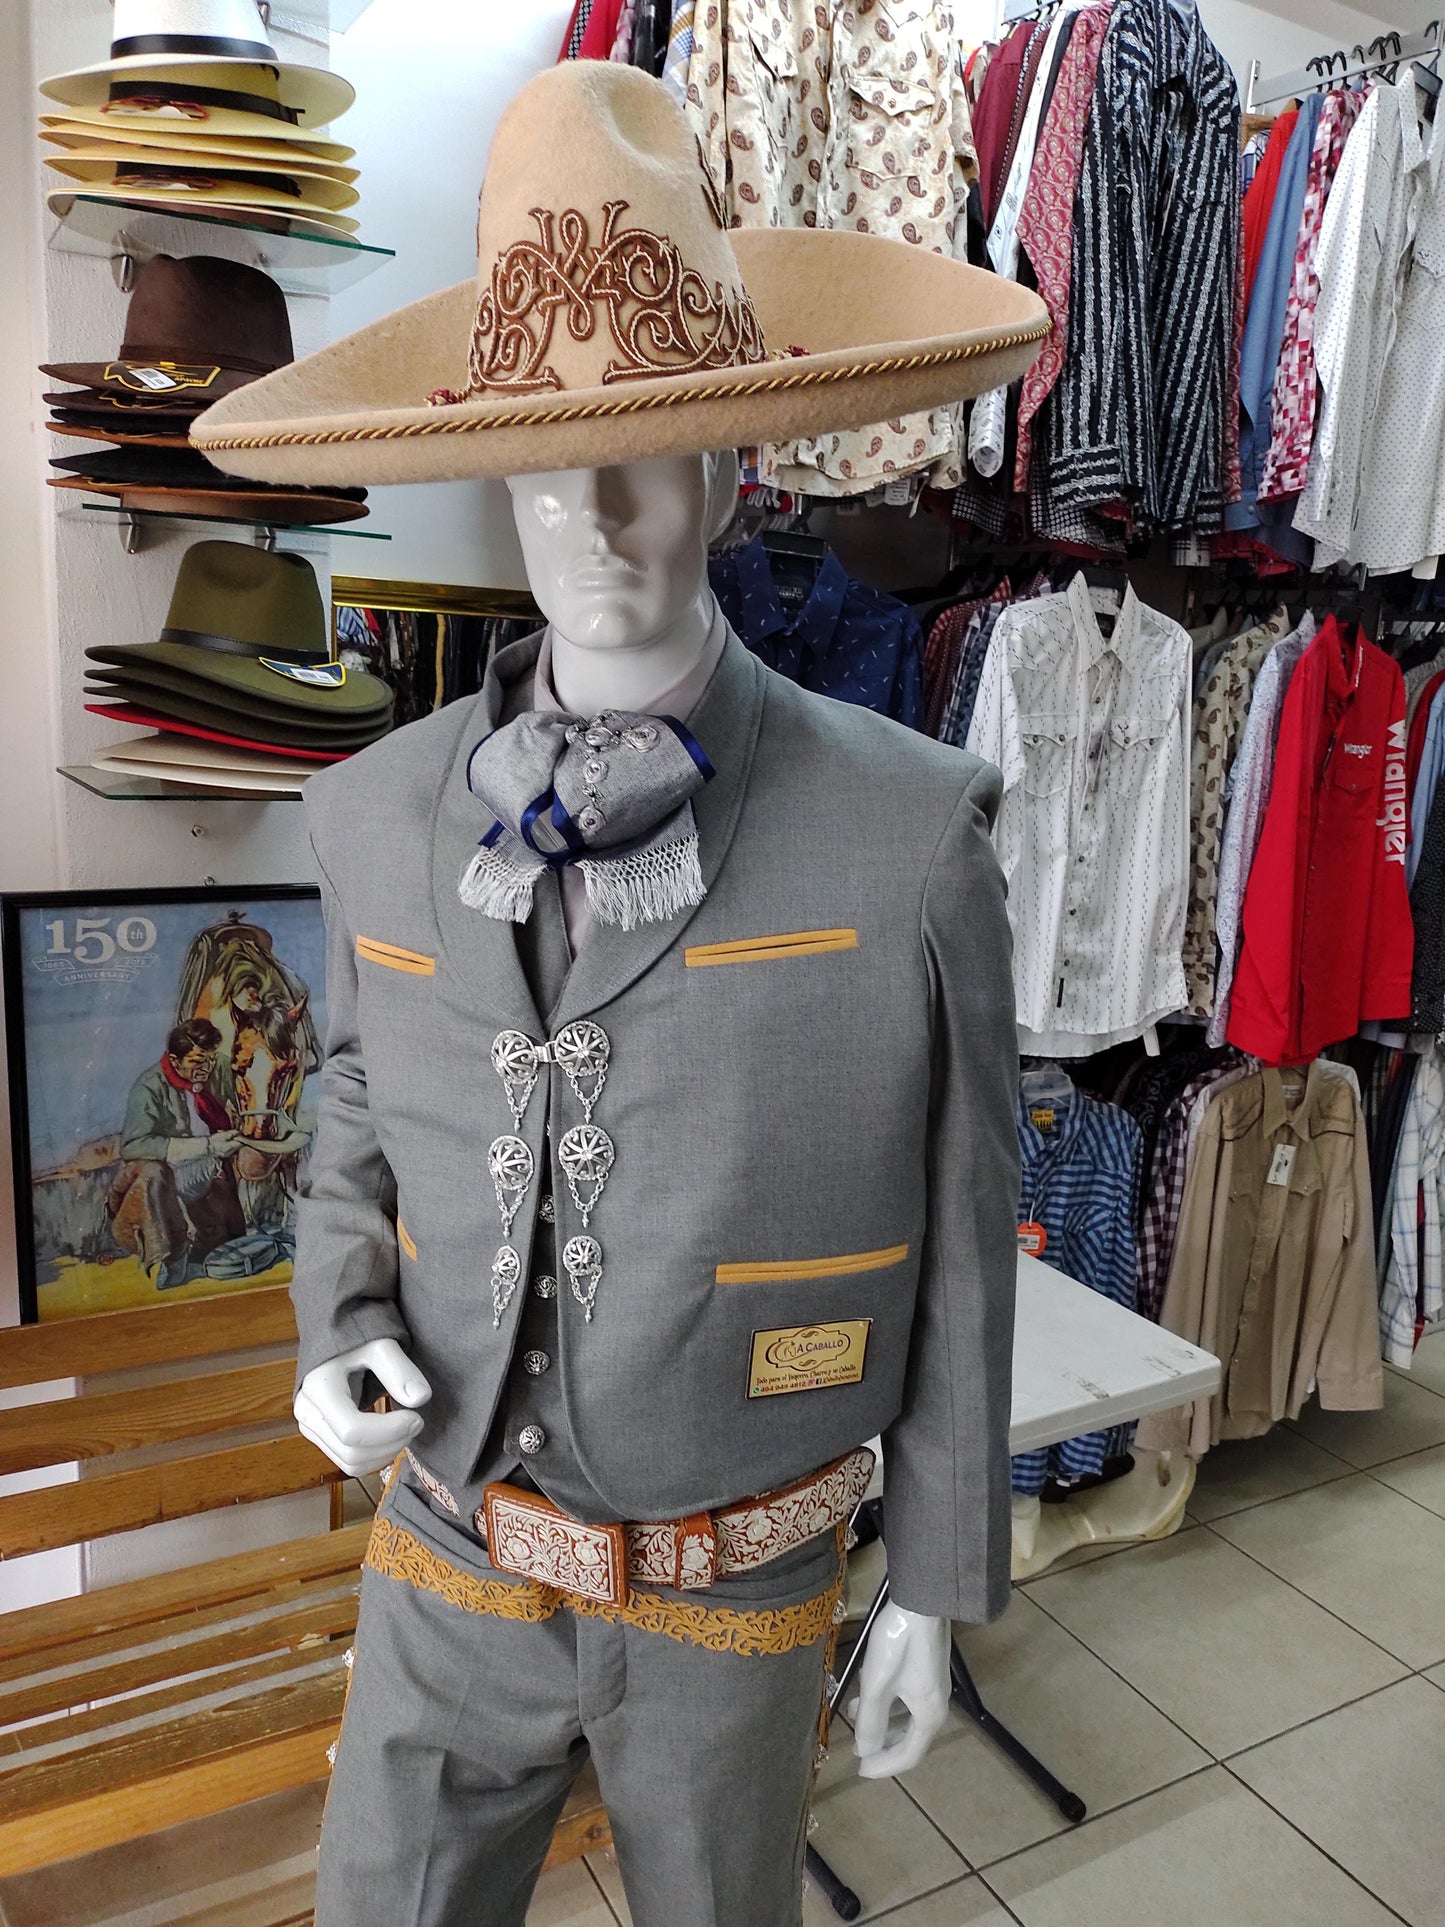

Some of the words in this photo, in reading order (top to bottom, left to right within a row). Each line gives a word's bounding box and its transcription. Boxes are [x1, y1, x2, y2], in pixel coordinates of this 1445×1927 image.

[1344, 743, 1372, 759] Wrangler
[1376, 719, 1407, 865] Wrangler
[64, 971, 130, 982] ANNIVERSARY
